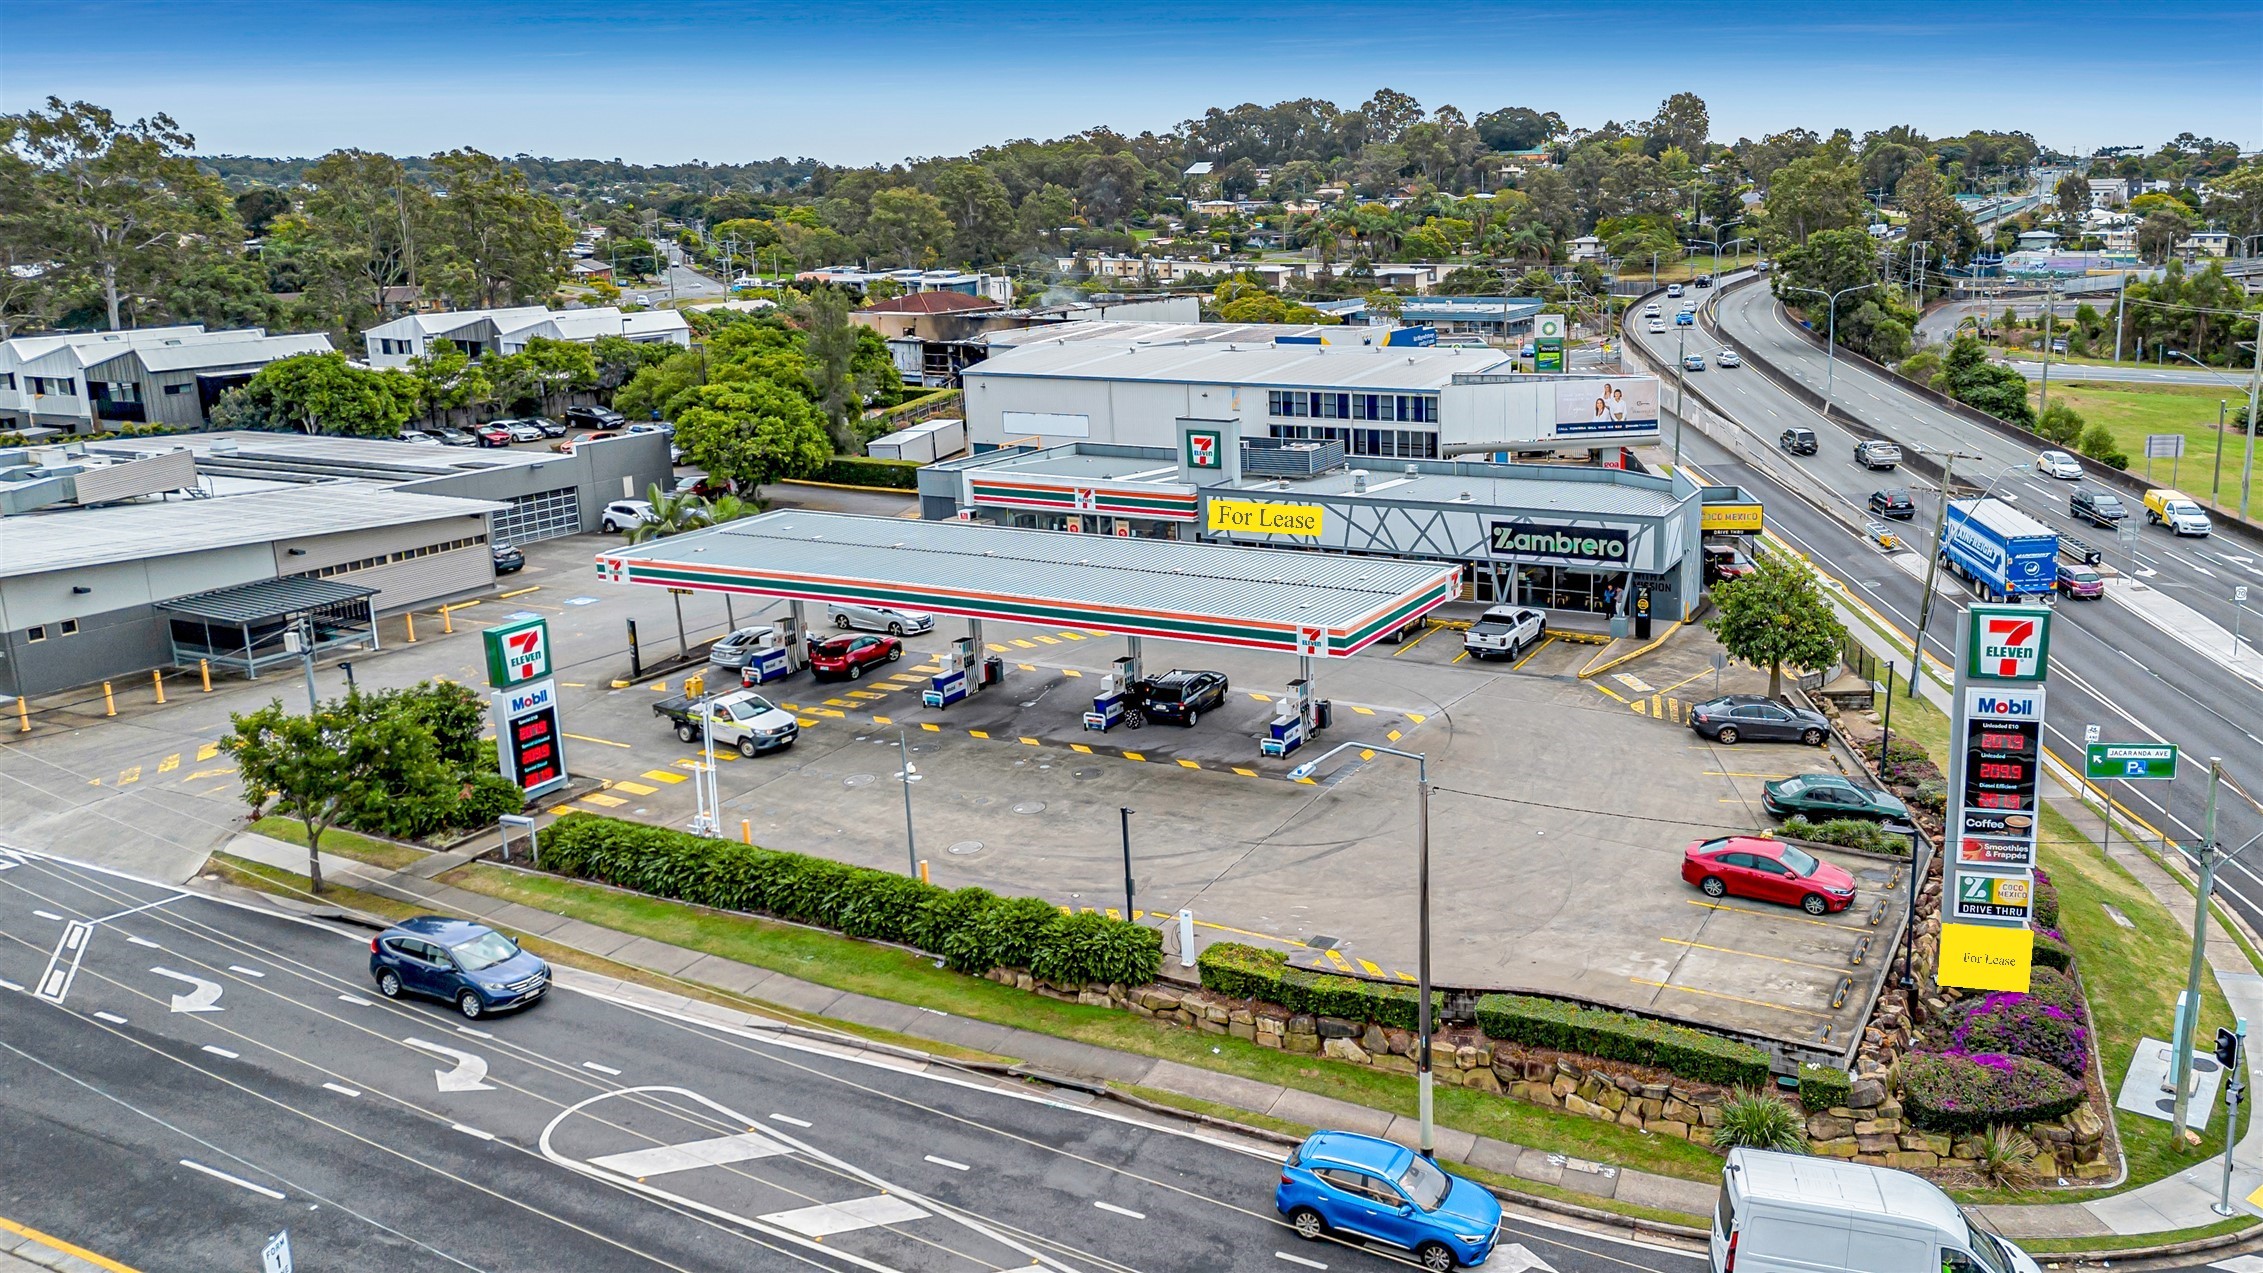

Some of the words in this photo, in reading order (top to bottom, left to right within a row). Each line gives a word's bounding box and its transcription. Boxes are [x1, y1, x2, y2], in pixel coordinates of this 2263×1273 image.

[1194, 437, 1212, 464] 7
[1725, 512, 1758, 521] MEXICO
[1493, 526, 1625, 558] Zambrero
[608, 560, 622, 582] 7
[1302, 627, 1321, 655] 7
[1989, 619, 2034, 676] 7
[509, 630, 539, 679] 7
[512, 689, 548, 712] Mobil
[1978, 697, 2033, 715] Mobil
[2127, 761, 2139, 773] P
[1965, 818, 2005, 829] Coffee
[1984, 843, 2029, 853] Smoothies
[1993, 851, 2027, 860] Frappés
[1997, 890, 2028, 899] MEXICO
[2002, 883, 2024, 892] COCO
[1962, 904, 1993, 915] DRIVE
[1995, 906, 2023, 916] THRU
[266, 1236, 285, 1260] FORM
[276, 1254, 281, 1269] 1
